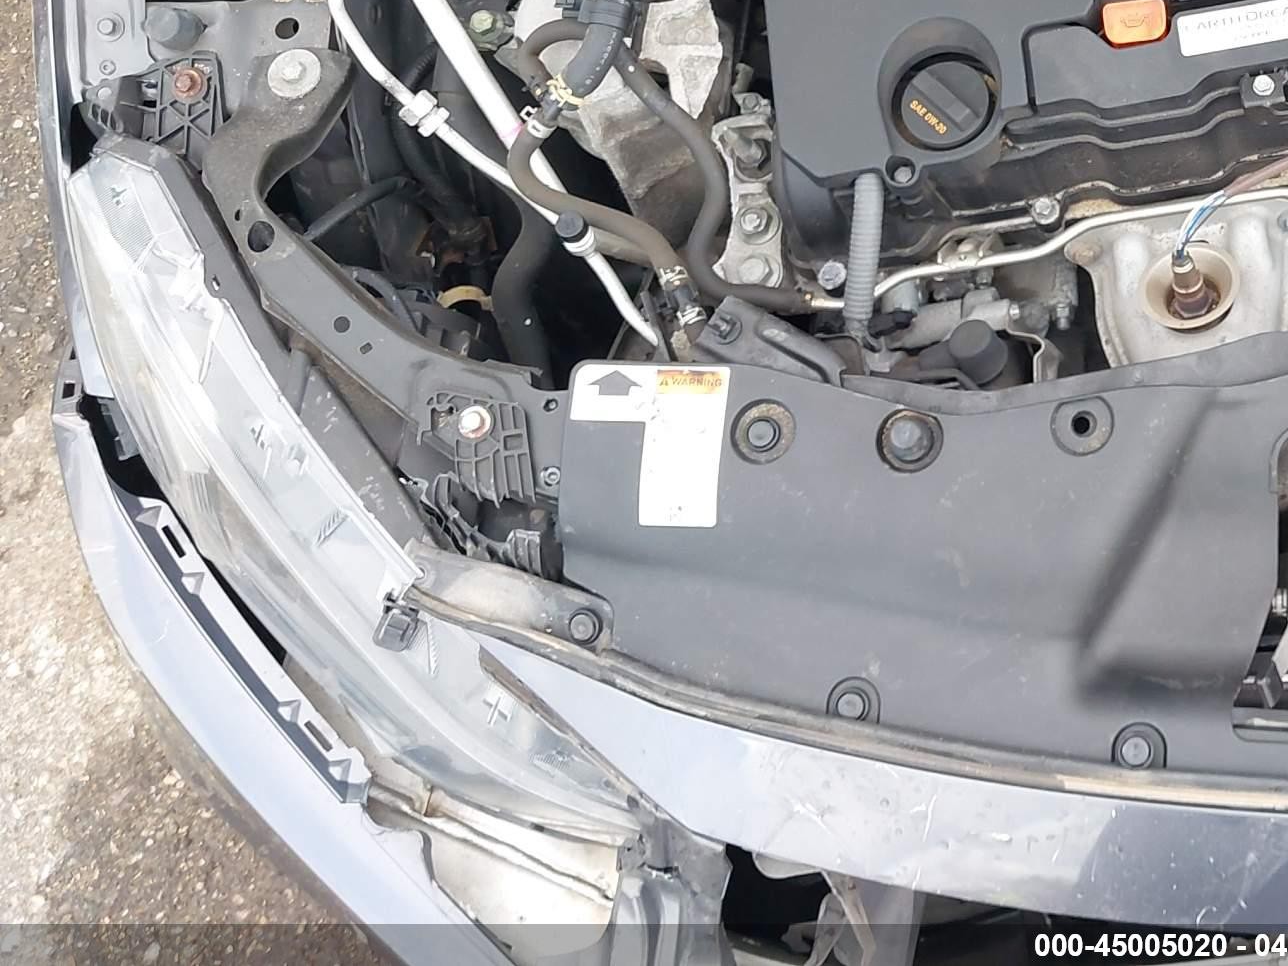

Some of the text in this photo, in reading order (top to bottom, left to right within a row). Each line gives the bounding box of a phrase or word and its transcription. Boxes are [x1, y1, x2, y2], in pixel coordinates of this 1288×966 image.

[910, 99, 947, 135] SAE 0W-20
[671, 375, 722, 387] WARNING
